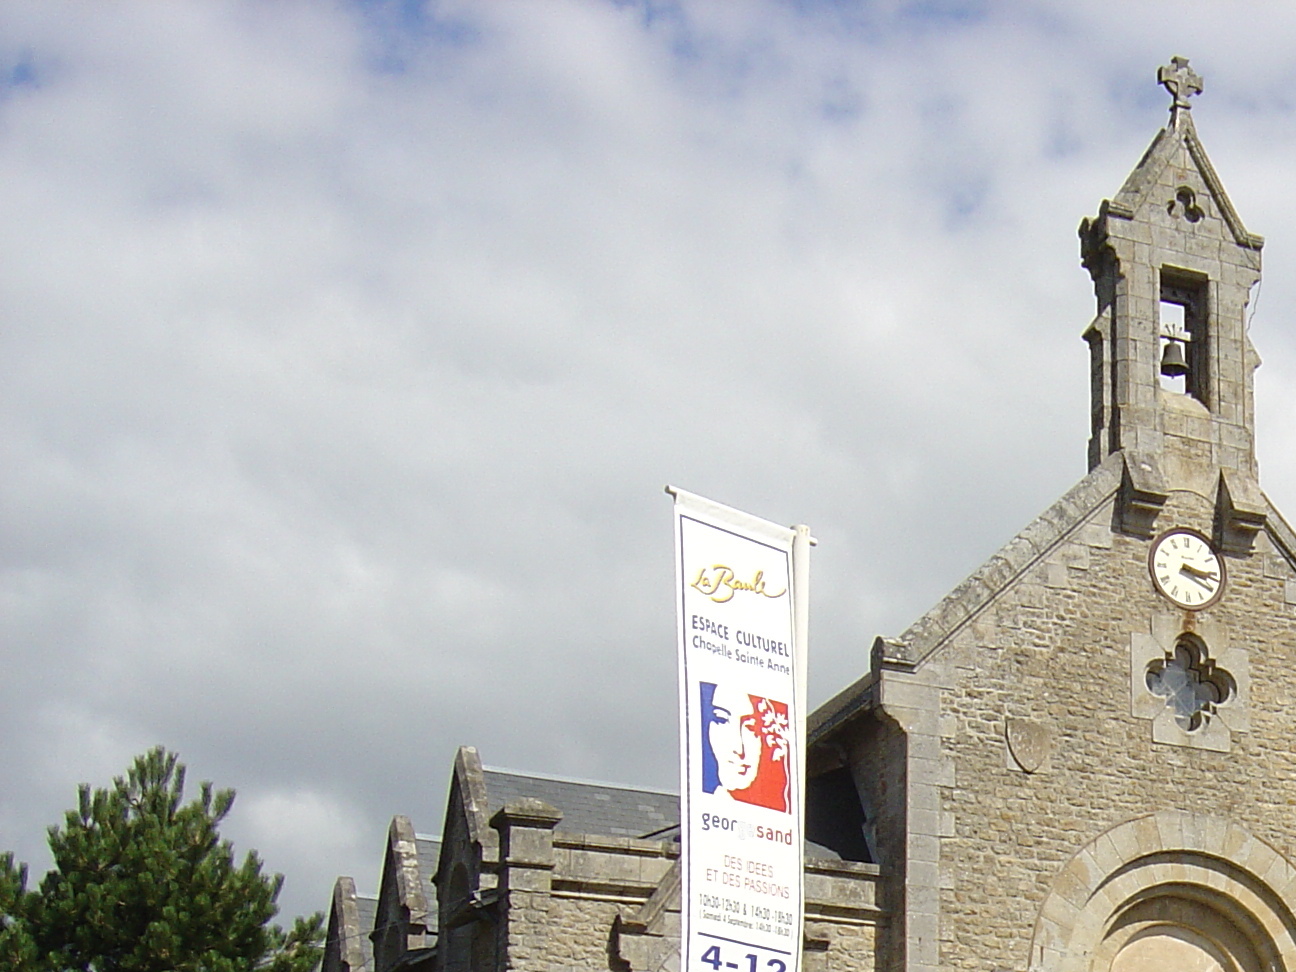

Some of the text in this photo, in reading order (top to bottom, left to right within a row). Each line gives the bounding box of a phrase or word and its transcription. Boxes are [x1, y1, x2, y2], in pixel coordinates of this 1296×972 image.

[691, 564, 787, 603] La Baule
[692, 615, 789, 657] ESPACE CULTUREL
[692, 635, 790, 675] Chapelle Sainte Anne
[756, 825, 792, 845] sand
[724, 855, 742, 871] DES
[706, 868, 789, 899] ET DES PASSIONS
